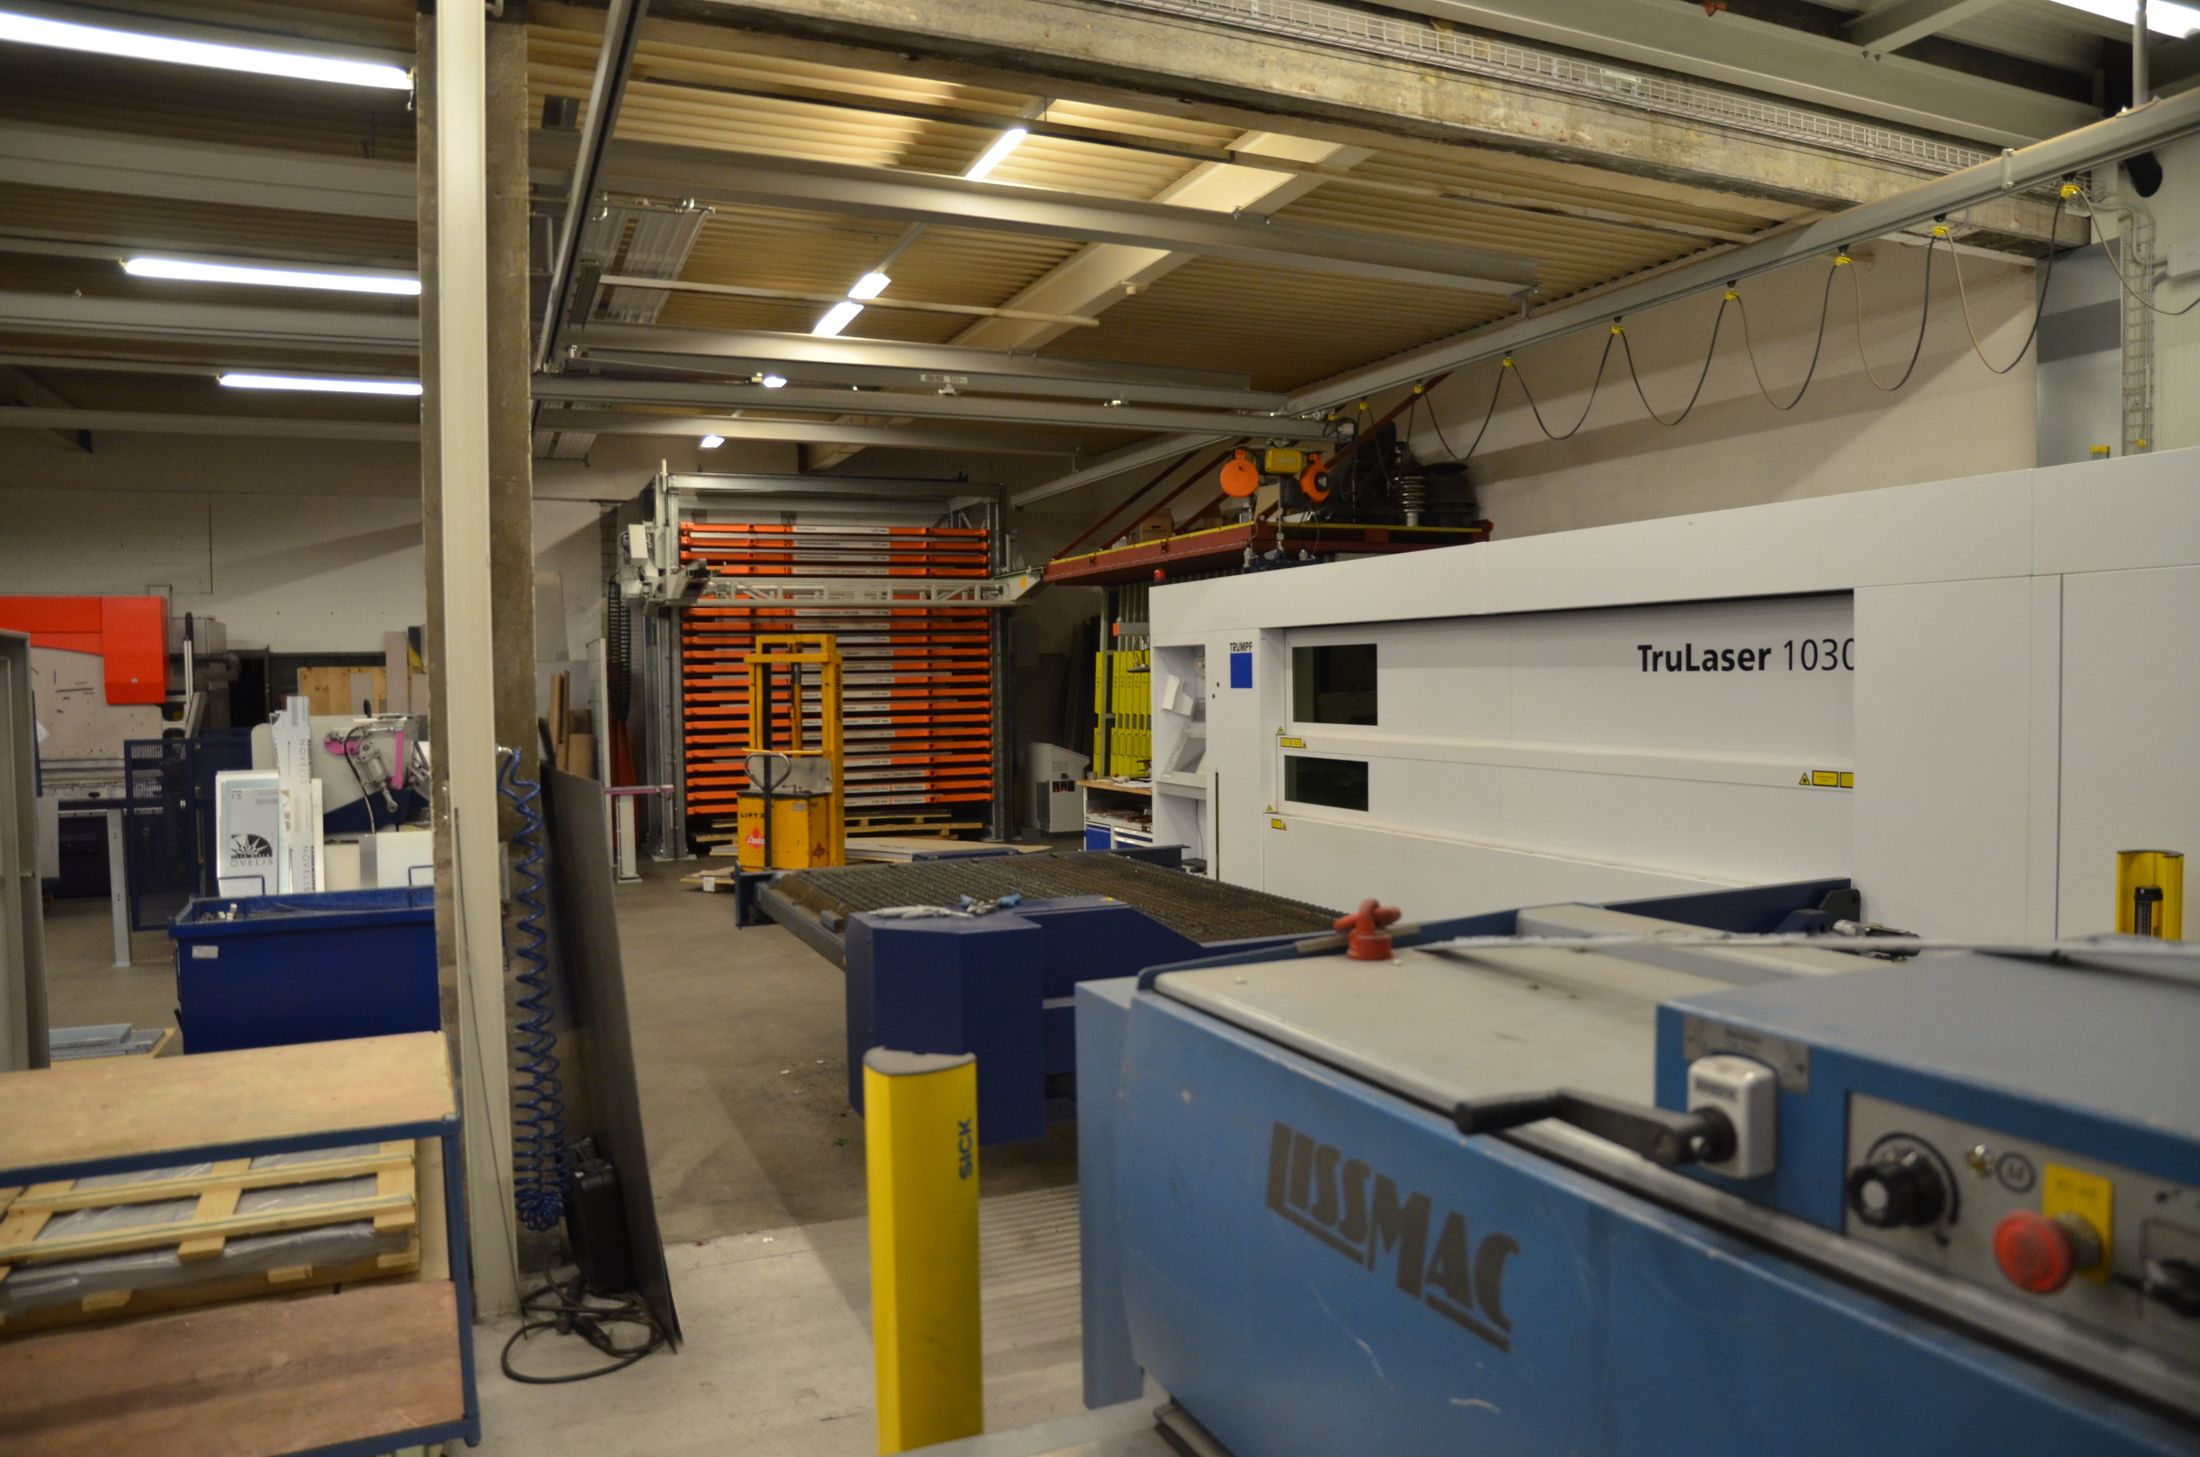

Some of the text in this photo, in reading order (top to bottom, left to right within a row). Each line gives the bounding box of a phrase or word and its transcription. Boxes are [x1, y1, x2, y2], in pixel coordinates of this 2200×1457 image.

[1229, 641, 1253, 652] TRUMPF
[1637, 638, 1855, 672] TruLaser 1030
[230, 859, 273, 868] OVELIS
[958, 1117, 973, 1180] SICK
[1266, 1119, 1520, 1353] LISSMAC
